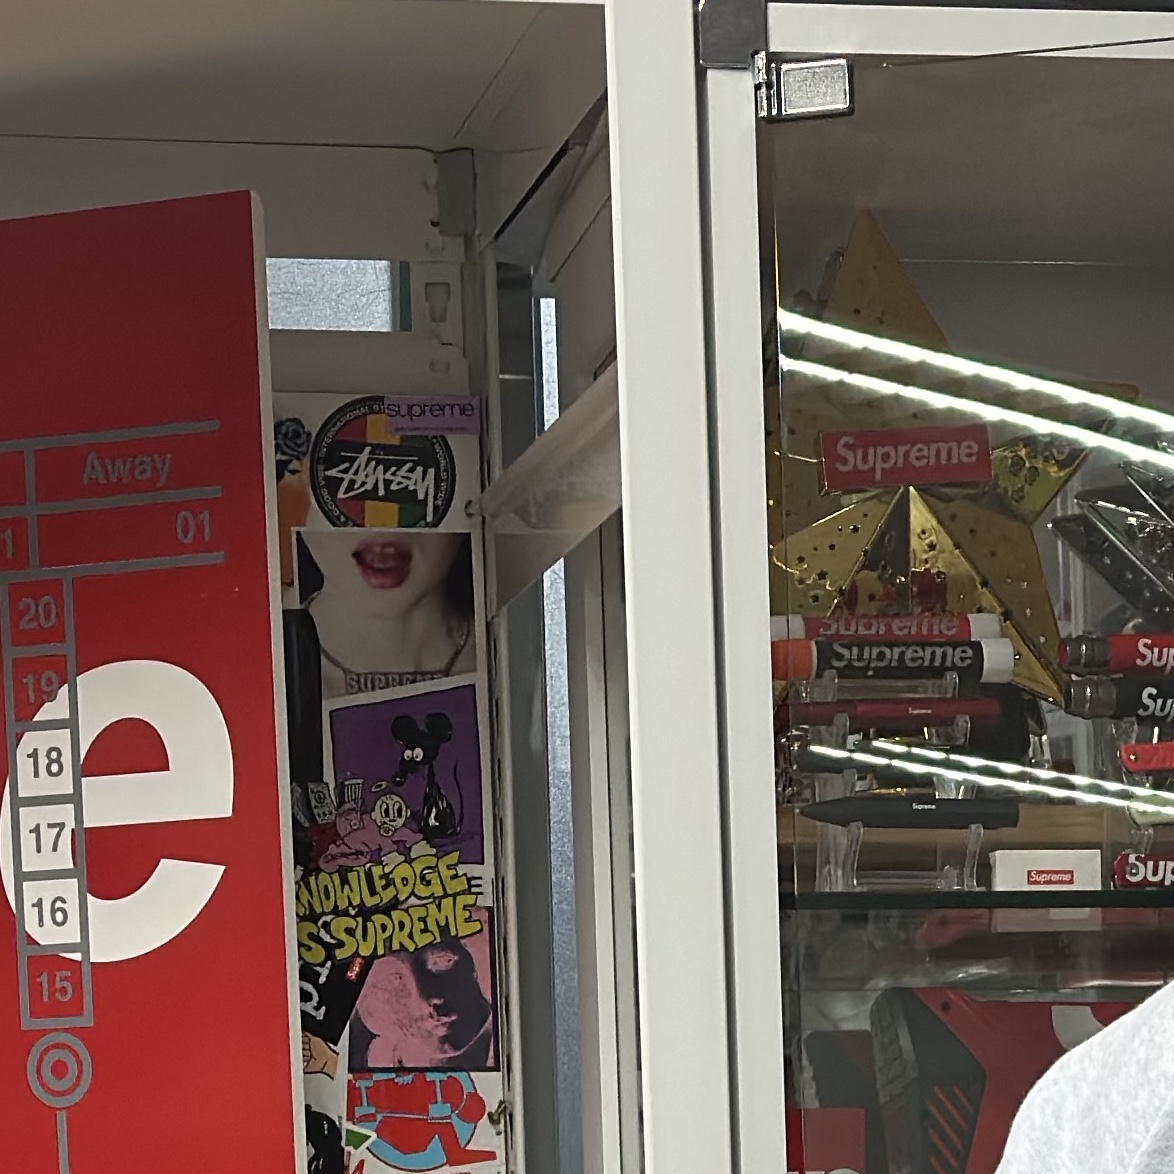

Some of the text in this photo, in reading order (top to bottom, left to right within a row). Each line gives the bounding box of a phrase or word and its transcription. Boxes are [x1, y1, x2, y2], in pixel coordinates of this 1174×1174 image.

[385, 402, 475, 421] supreme
[82, 451, 172, 487] Away
[834, 435, 979, 481] Supreme
[174, 509, 212, 544] 01
[18, 595, 57, 630] 20
[831, 640, 974, 676] Supreme
[21, 669, 60, 704] 19
[25, 746, 64, 779] 18
[28, 822, 67, 854] 17
[1030, 871, 1072, 885] Supreme
[31, 896, 69, 928] 16
[297, 894, 484, 965] S SUPREME
[36, 970, 74, 1003] 15
